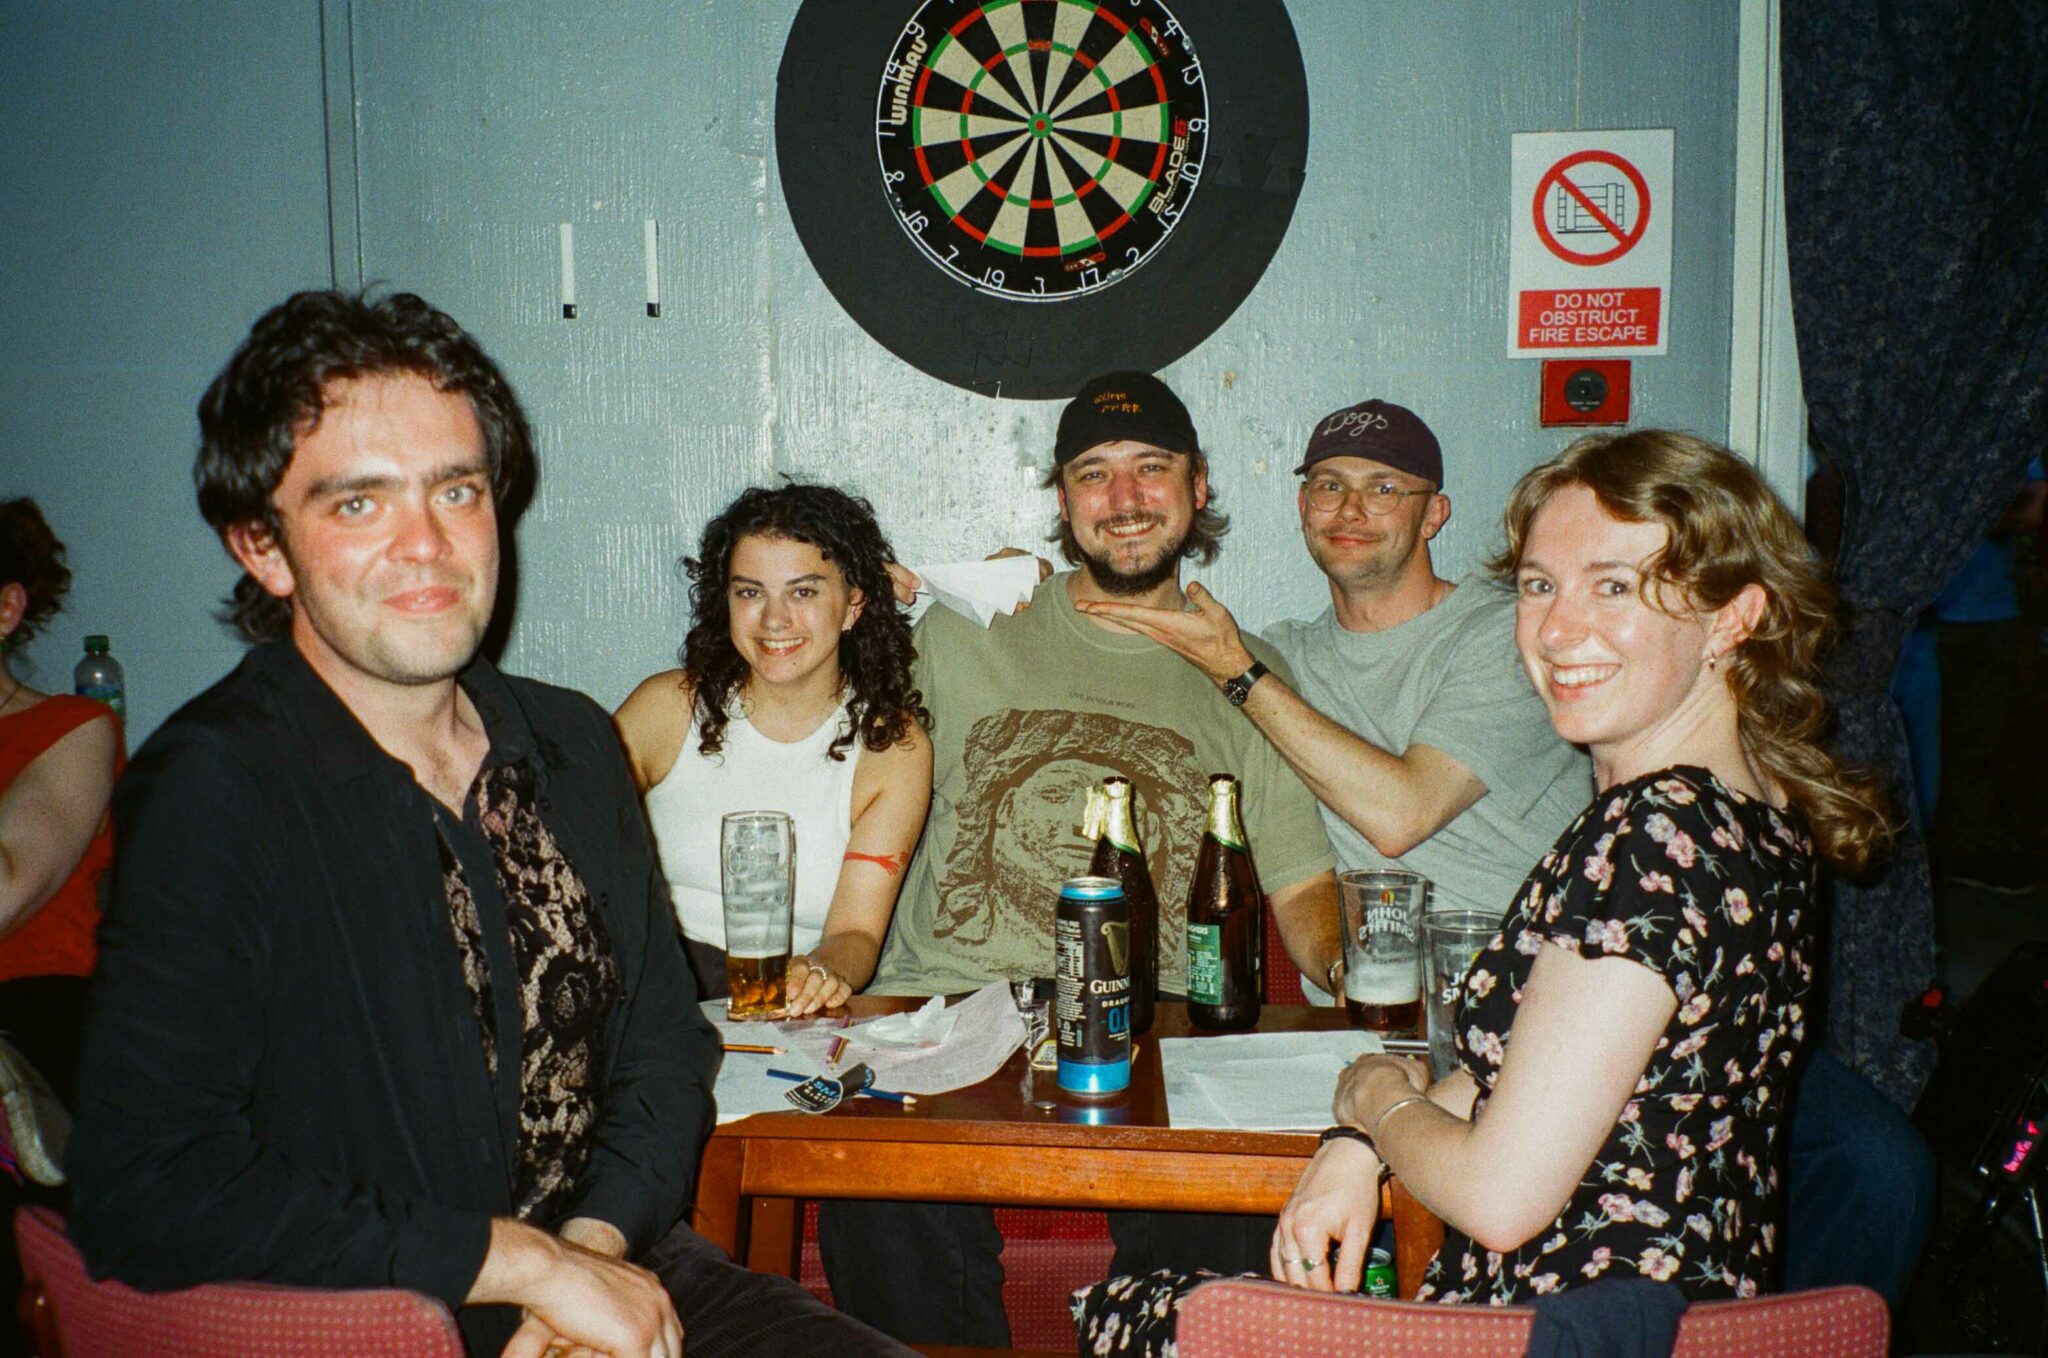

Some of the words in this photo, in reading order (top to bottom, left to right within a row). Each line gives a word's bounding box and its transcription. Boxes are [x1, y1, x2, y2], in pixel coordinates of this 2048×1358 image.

[1555, 293, 1582, 308] DO
[1586, 292, 1626, 307] NOT
[1540, 308, 1639, 326] OBSTRUCT
[1529, 327, 1569, 342] FIRE
[1574, 325, 1647, 342] ESCAPE
[1322, 411, 1389, 437] Dogs
[1090, 975, 1131, 994] GUINN
